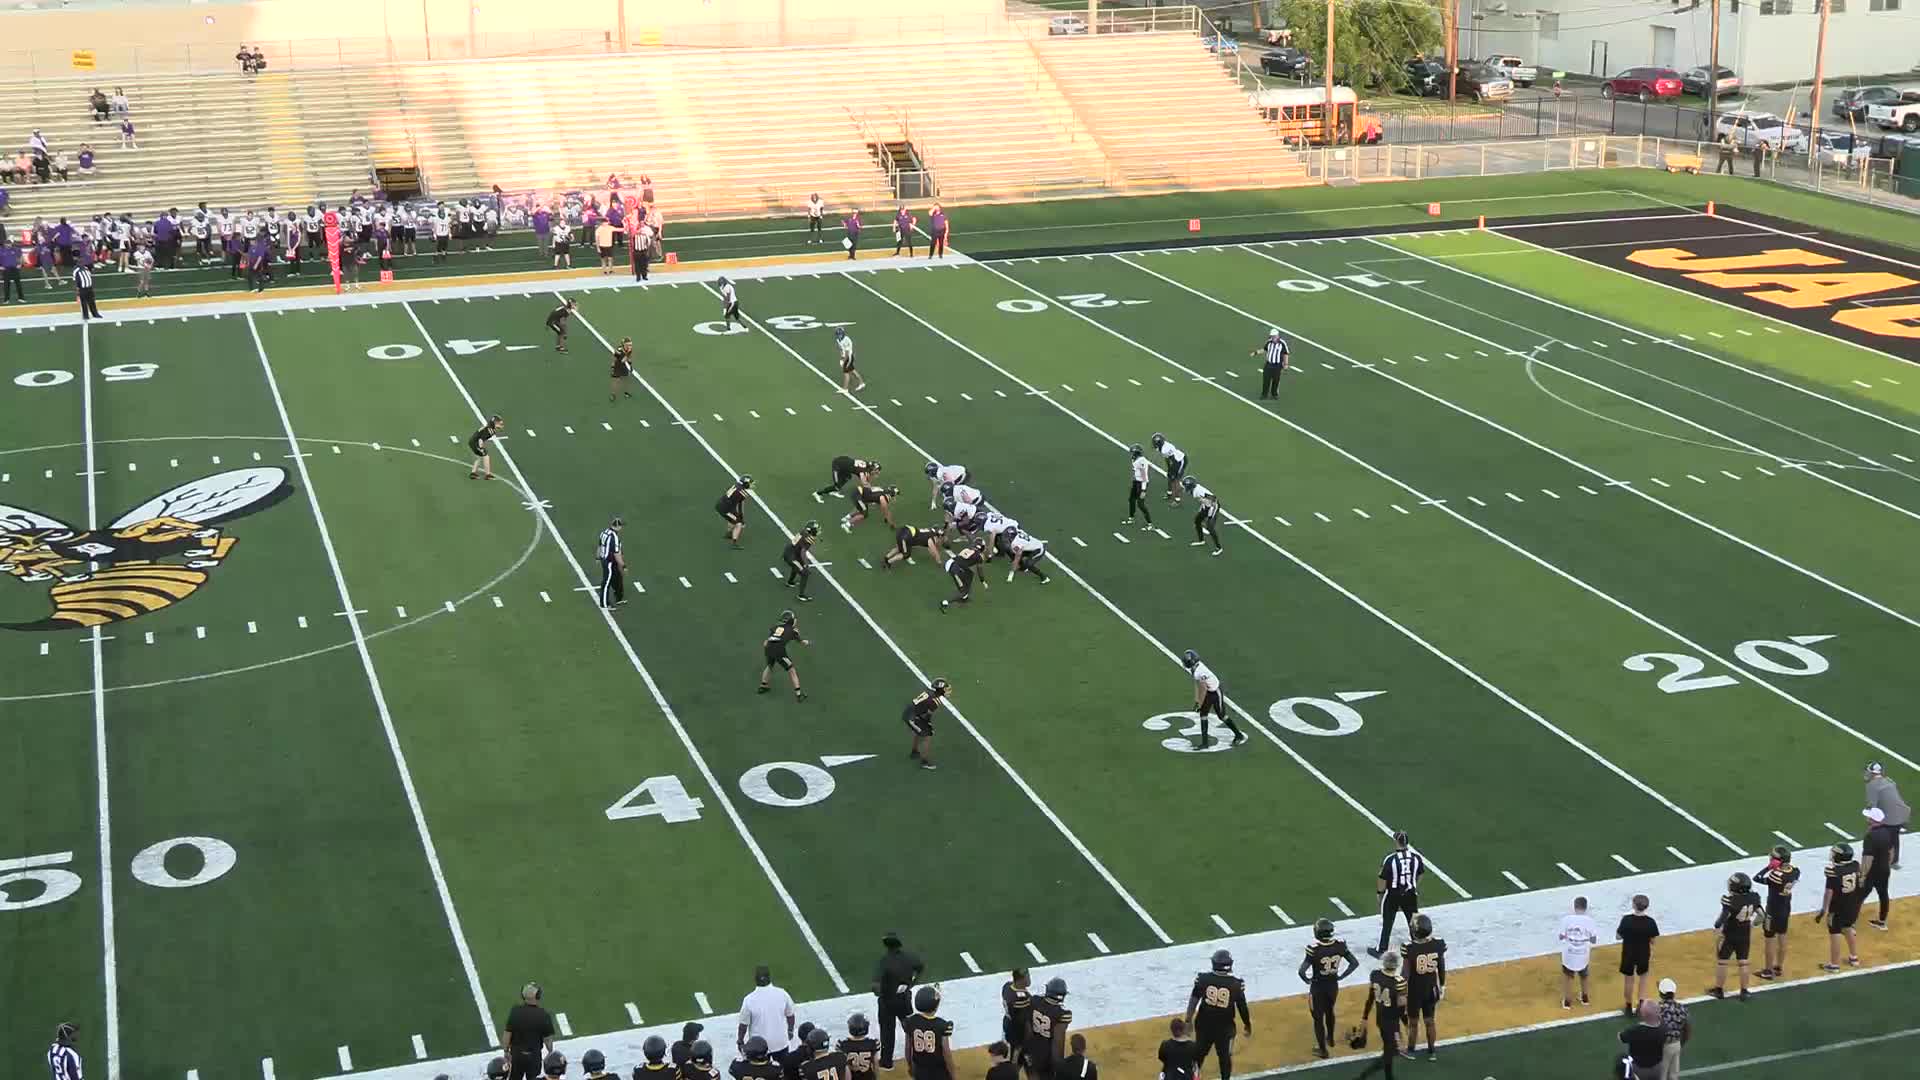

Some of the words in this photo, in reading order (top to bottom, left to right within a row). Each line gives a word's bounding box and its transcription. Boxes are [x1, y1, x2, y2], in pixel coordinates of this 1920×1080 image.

[1416, 952, 1439, 975] 85
[1205, 984, 1230, 1008] 99
[1032, 1009, 1051, 1039] 52
[913, 1029, 937, 1053] 68
